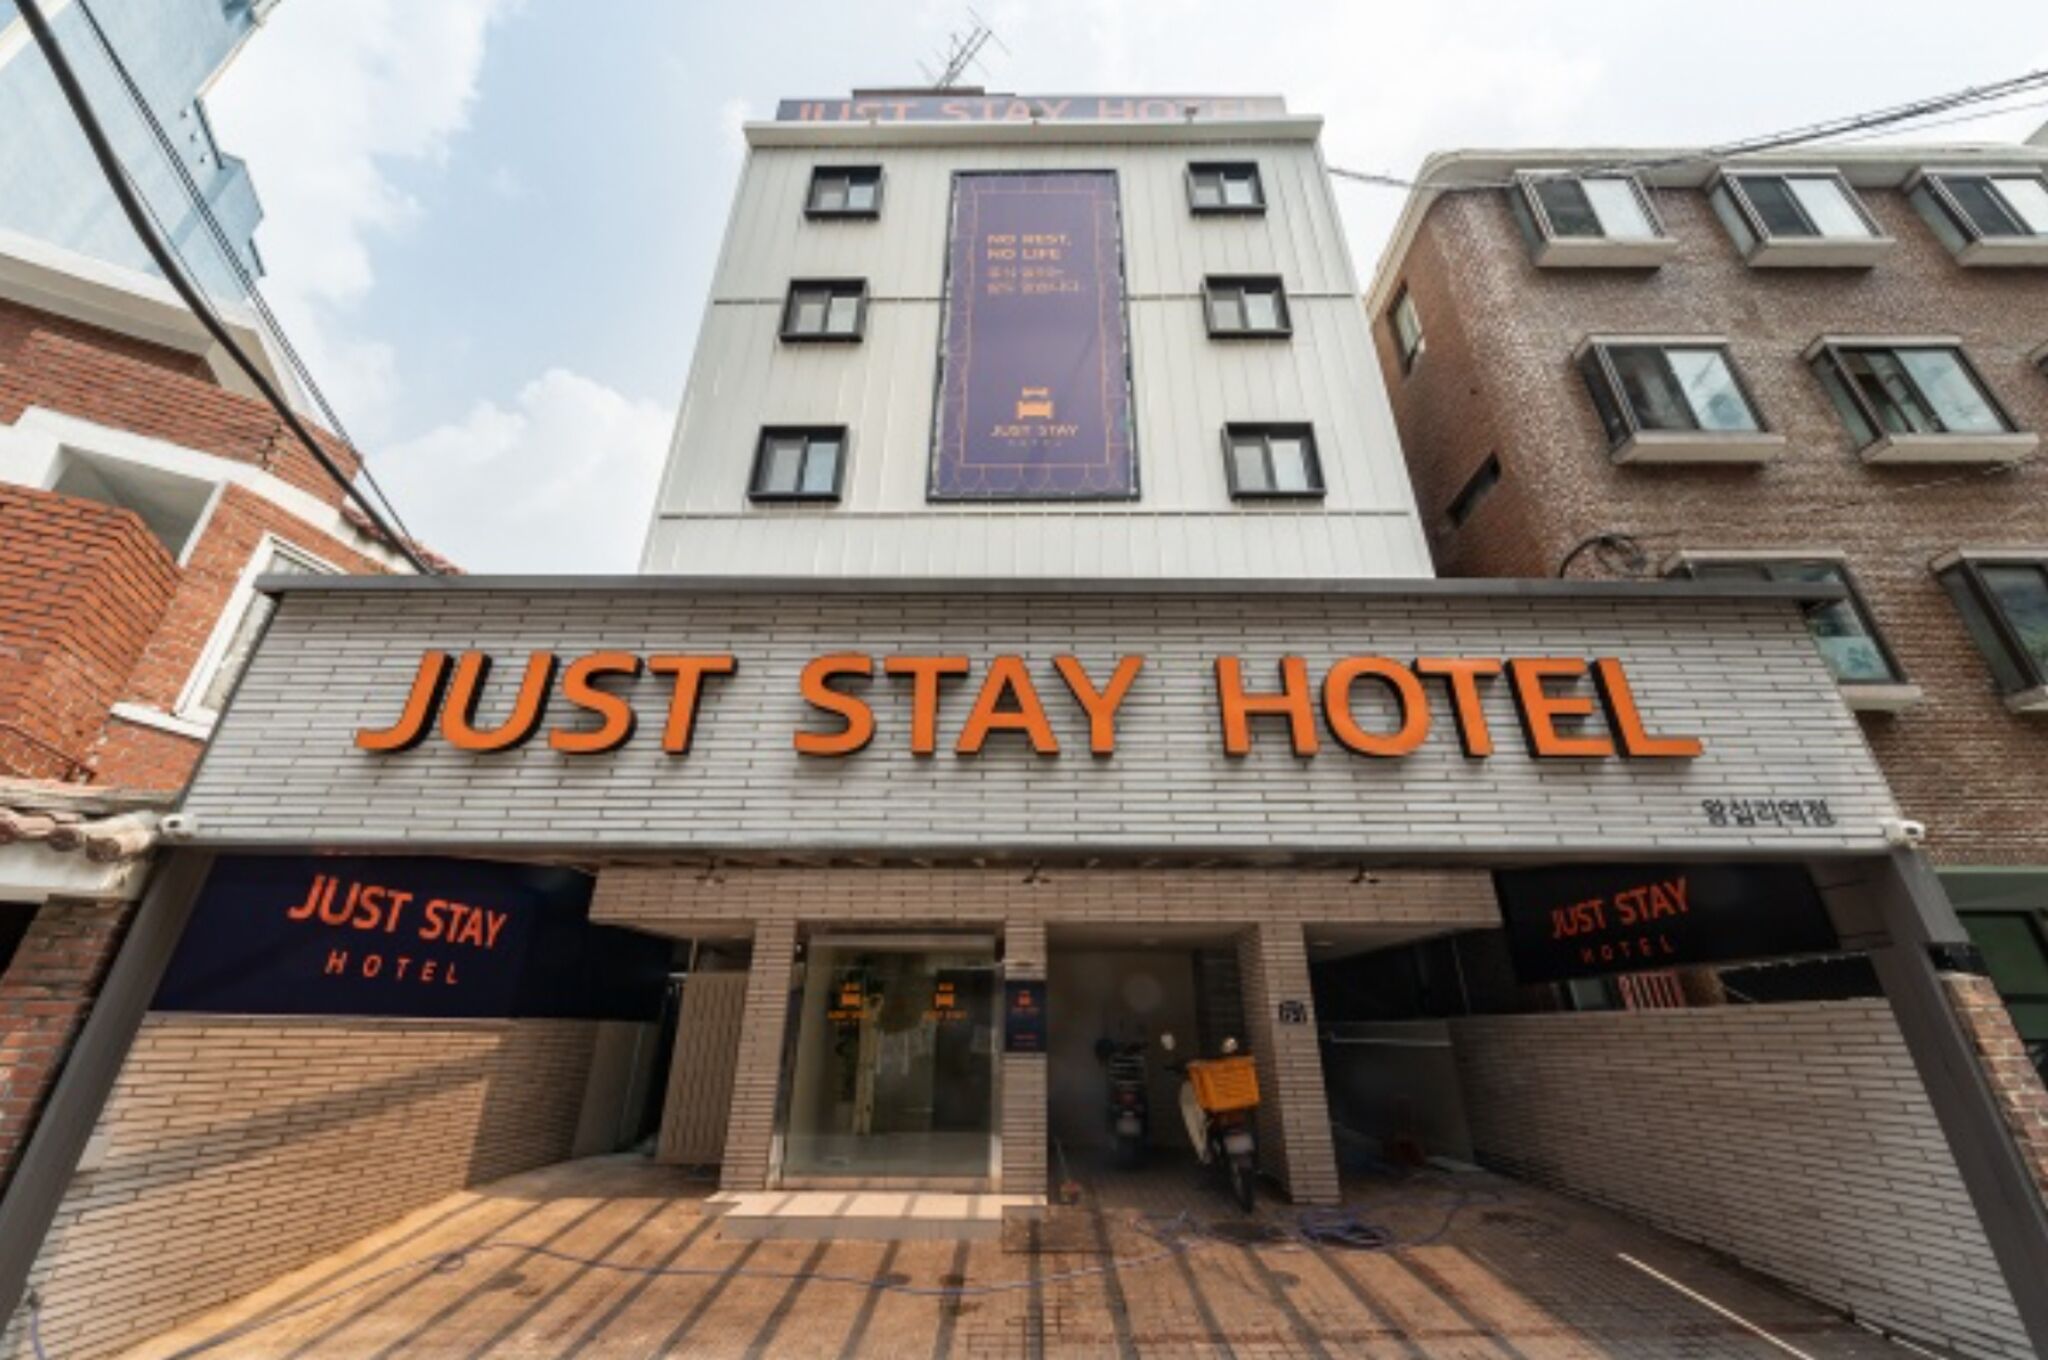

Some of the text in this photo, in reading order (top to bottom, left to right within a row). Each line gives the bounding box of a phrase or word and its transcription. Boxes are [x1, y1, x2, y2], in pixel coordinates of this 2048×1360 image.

[987, 234, 1016, 245] NO
[987, 248, 1016, 260] NO
[990, 424, 1079, 437] JUST STAY
[356, 650, 1703, 758] JUST STAY HOTEL
[1701, 798, 1837, 828] 왕십리역점
[287, 874, 507, 949] JUST STAY
[1551, 875, 1690, 940] JUST STAY
[1581, 934, 1675, 964] HOTEL
[324, 949, 459, 986] HOTEL
